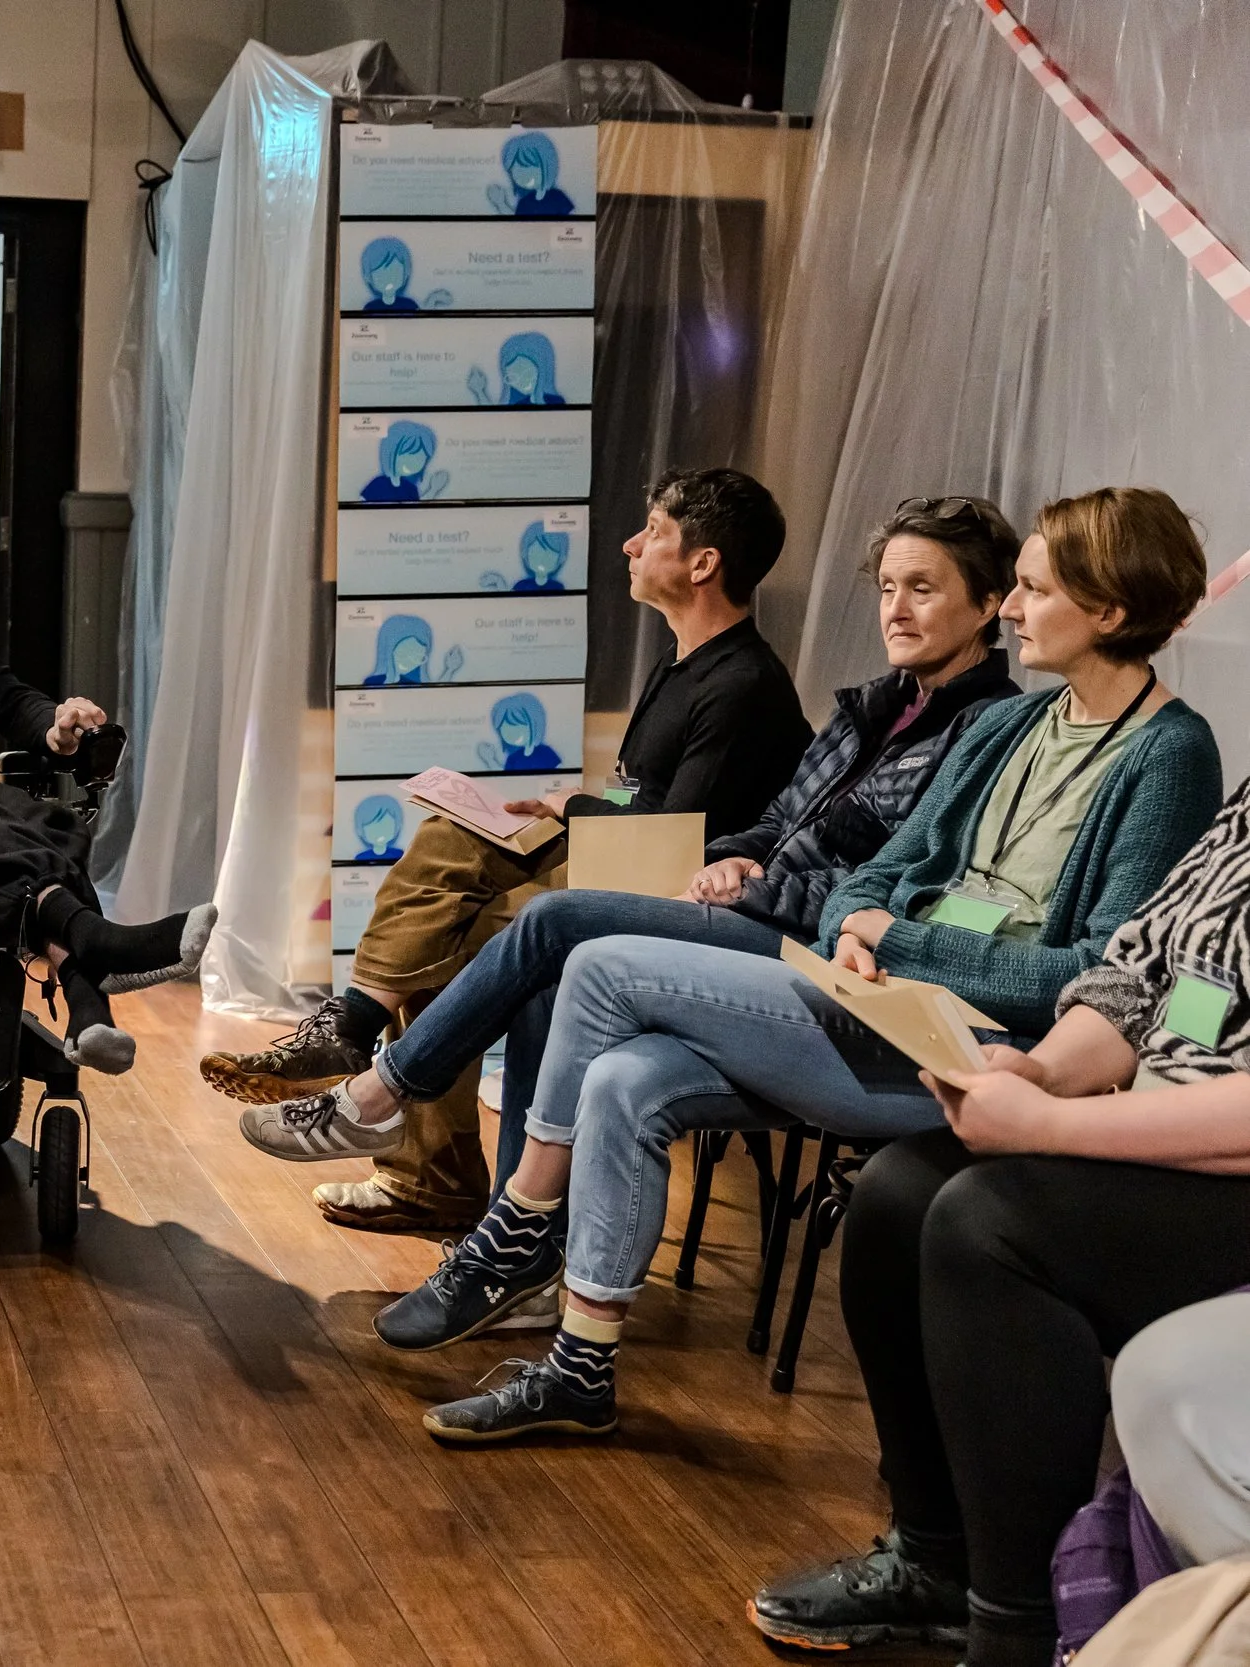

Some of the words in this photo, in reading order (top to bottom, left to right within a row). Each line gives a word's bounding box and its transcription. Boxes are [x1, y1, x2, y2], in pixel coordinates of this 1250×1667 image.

[368, 157, 388, 167] you
[390, 155, 415, 165] need
[417, 155, 456, 165] medical
[468, 251, 503, 263] Need
[506, 254, 515, 263] a
[518, 251, 551, 263] test?
[351, 352, 372, 362] Our
[375, 352, 400, 362] staff
[416, 352, 441, 362] here
[444, 352, 456, 362] to
[389, 367, 418, 379] help!
[388, 532, 423, 544] Need
[426, 534, 434, 543] a
[438, 531, 470, 543] test?
[475, 618, 495, 628] Our
[498, 617, 523, 628] staff
[537, 617, 562, 627] here
[564, 617, 576, 627] to
[511, 632, 539, 644] help!
